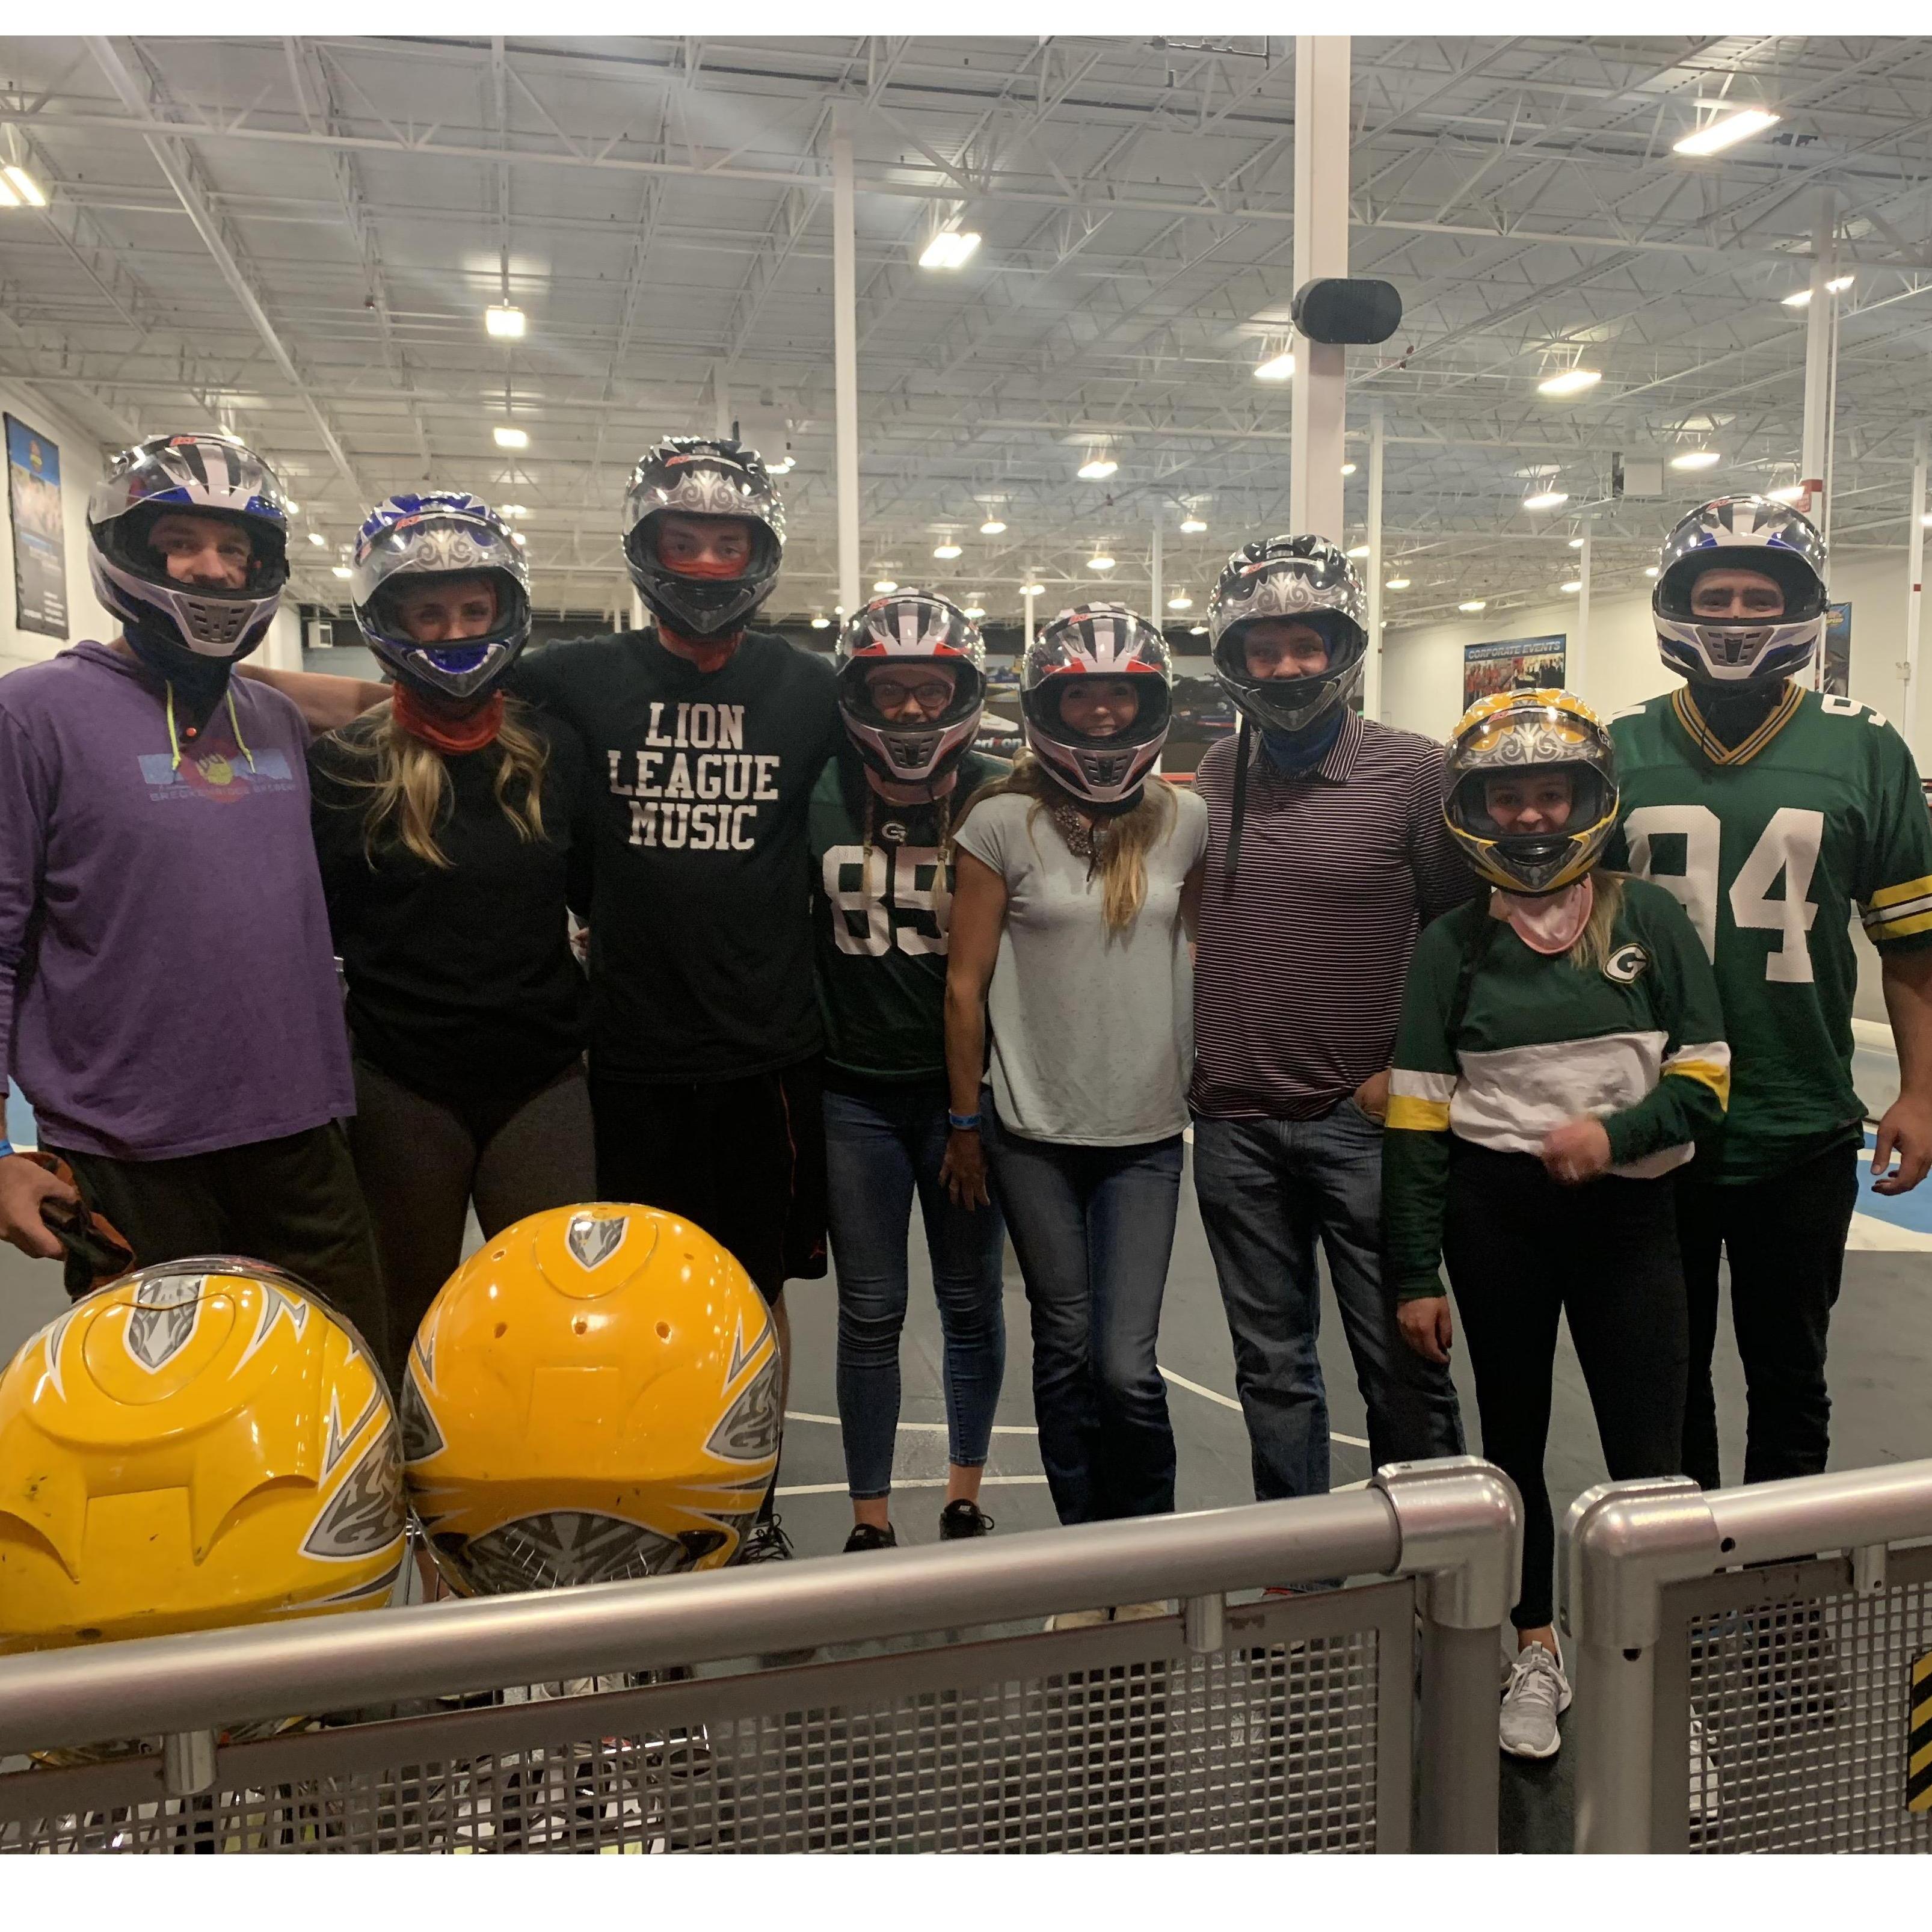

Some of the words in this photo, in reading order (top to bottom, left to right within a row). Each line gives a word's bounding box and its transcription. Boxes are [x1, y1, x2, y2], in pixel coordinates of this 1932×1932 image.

[1468, 644, 1521, 660] CORPORATE
[1522, 641, 1561, 654] EVENTS
[645, 702, 745, 750] LION
[608, 750, 780, 800] LEAGUE
[629, 801, 757, 850] MUSIC
[823, 845, 953, 956] 85
[1623, 805, 1824, 983] 94
[1605, 944, 1647, 982] G
